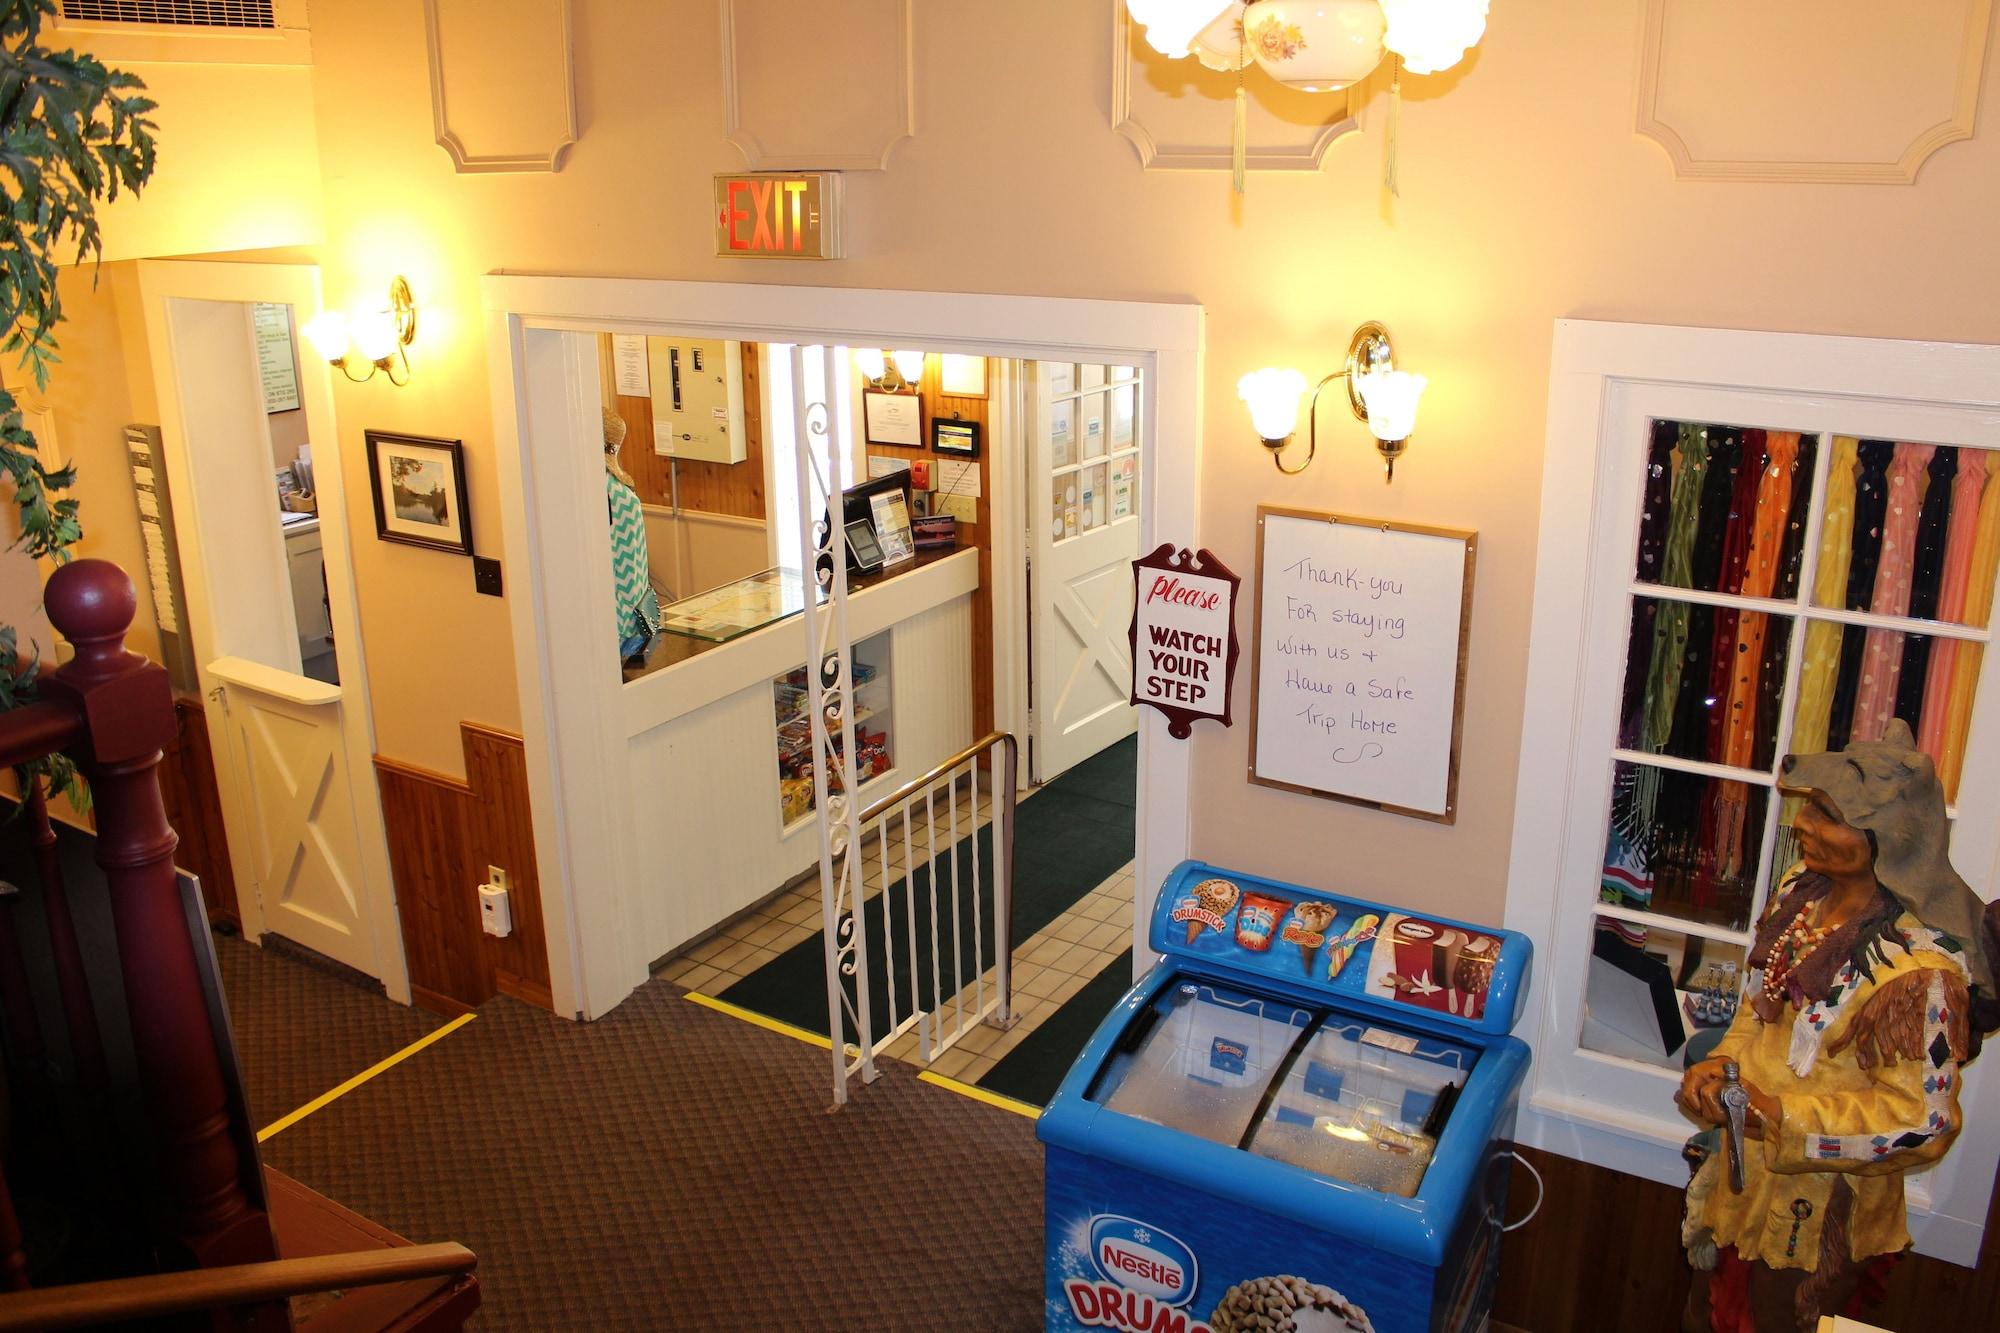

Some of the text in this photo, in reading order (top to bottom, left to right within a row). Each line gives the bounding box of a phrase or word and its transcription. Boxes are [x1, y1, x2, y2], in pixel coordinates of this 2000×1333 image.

[728, 181, 807, 251] EXIT
[1149, 624, 1222, 658] WATCH
[1327, 647, 1350, 660] us
[1149, 650, 1210, 682] YOUR
[1147, 676, 1206, 704] STEP
[1173, 908, 1226, 933] DRUMSTICK
[1069, 1283, 1212, 1333] DRUM
